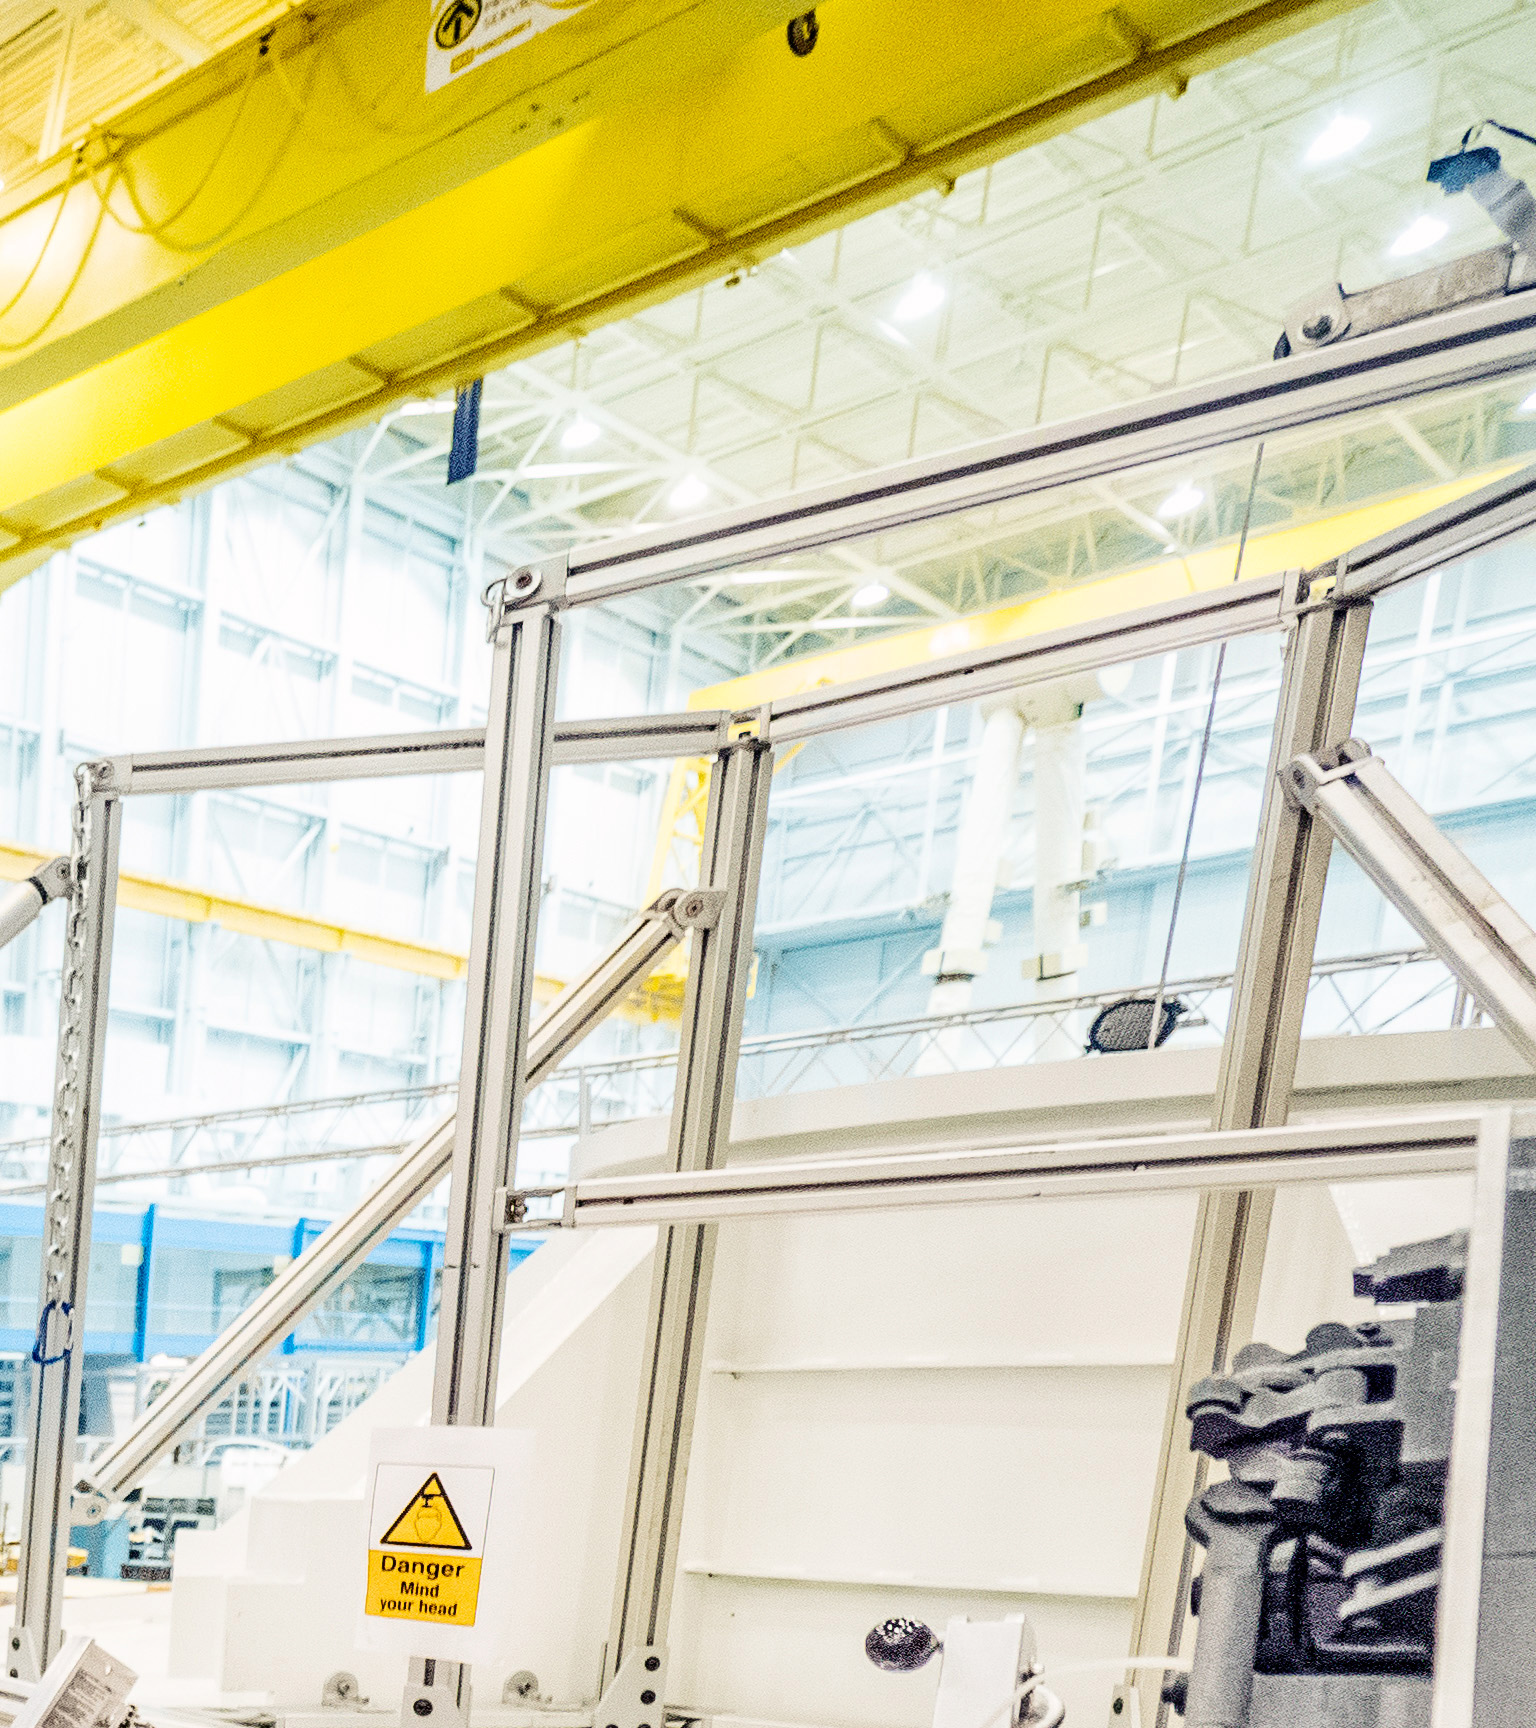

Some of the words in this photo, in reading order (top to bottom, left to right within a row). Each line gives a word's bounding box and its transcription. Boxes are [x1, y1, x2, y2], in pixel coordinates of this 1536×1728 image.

[381, 1555, 465, 1580] Danger
[400, 1581, 440, 1598] Mind
[380, 1599, 414, 1613] your
[419, 1599, 458, 1616] head
